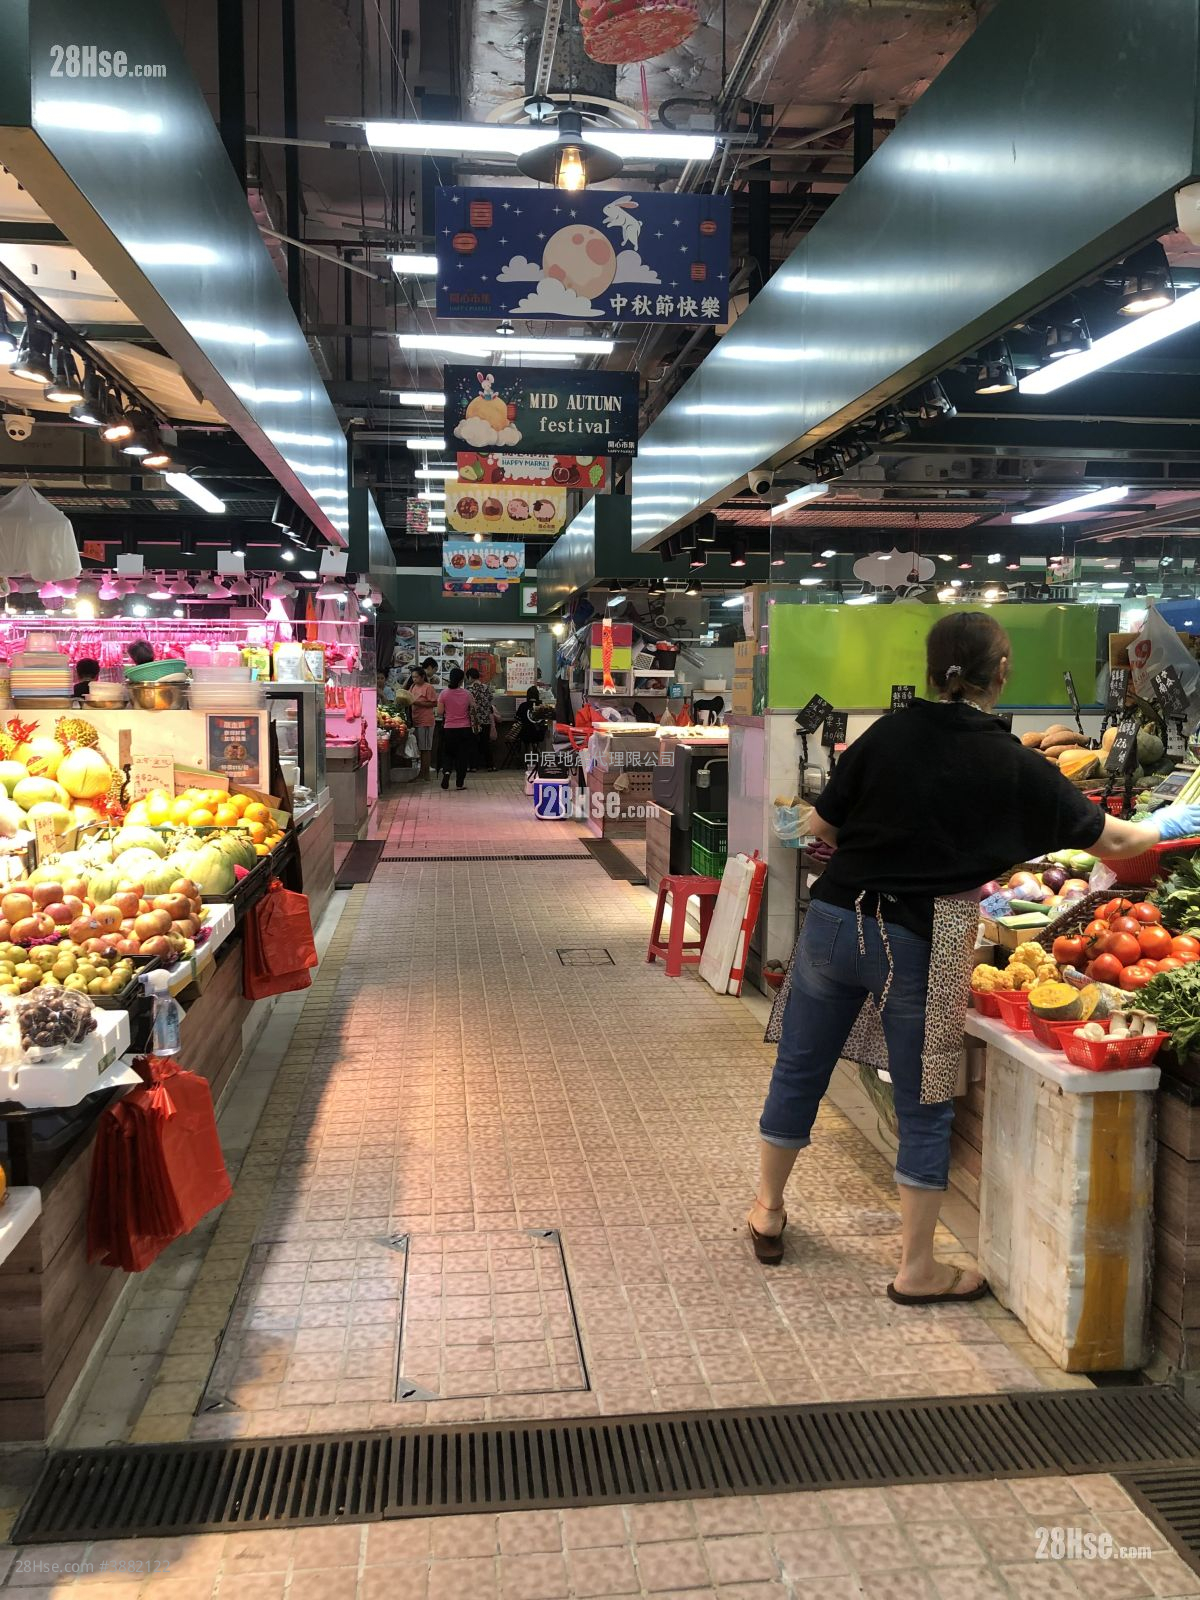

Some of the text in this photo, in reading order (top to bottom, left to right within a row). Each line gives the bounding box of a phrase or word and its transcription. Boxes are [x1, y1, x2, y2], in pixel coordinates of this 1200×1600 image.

[609, 293, 721, 319] 中秋節快樂
[529, 393, 622, 412] MID AUTUMN
[540, 416, 611, 434] festival
